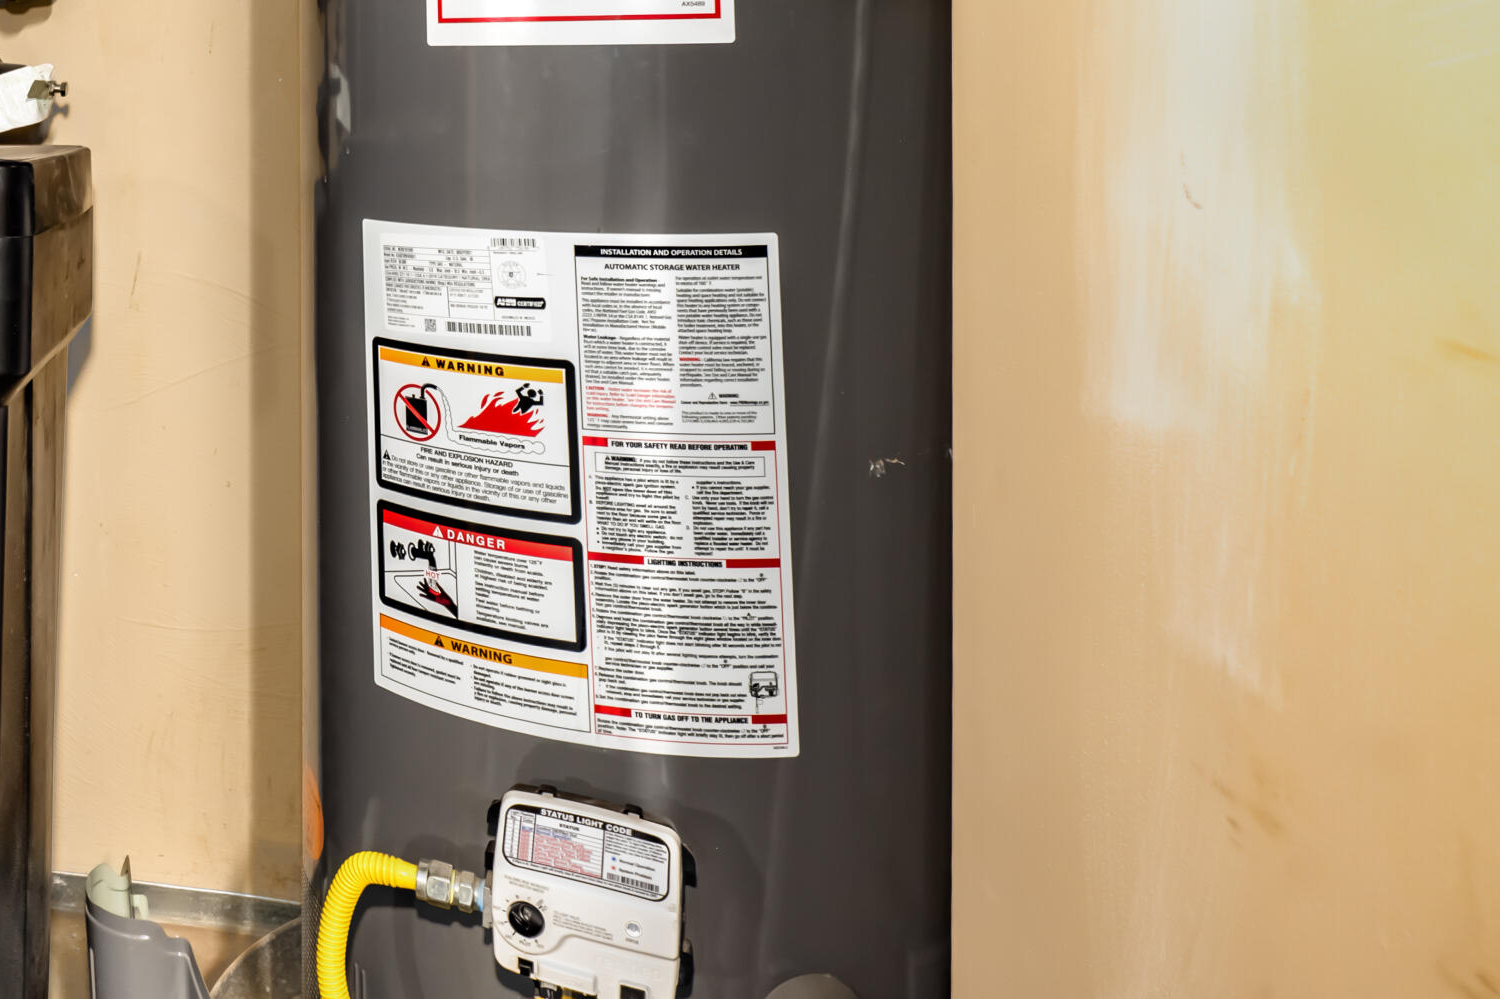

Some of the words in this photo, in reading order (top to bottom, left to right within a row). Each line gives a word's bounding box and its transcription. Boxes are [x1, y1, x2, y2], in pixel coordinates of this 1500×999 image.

[600, 248, 652, 256] INSTALLATION
[653, 248, 669, 256] AND
[671, 248, 712, 256] OPERATION
[713, 248, 743, 256] DETAILS
[650, 263, 684, 271] STORAGE
[685, 263, 710, 271] WATER
[712, 263, 740, 271] HEATER
[436, 359, 504, 376] WARNING
[459, 434, 497, 446] Flammable
[500, 440, 525, 449] Vapors
[611, 440, 624, 448] FOR
[626, 441, 642, 449] YOUR
[448, 452, 483, 463] EXPLOSION
[486, 458, 513, 468] HAZARD
[447, 529, 505, 550] DANGER
[678, 560, 722, 568] INSTRUCTIONS
[425, 570, 440, 579] HOT
[451, 640, 513, 665] WARNING
[645, 712, 661, 720] TURN
[540, 808, 574, 822] STATUS
[576, 816, 604, 829] LIGHT
[605, 823, 632, 836] CODE
